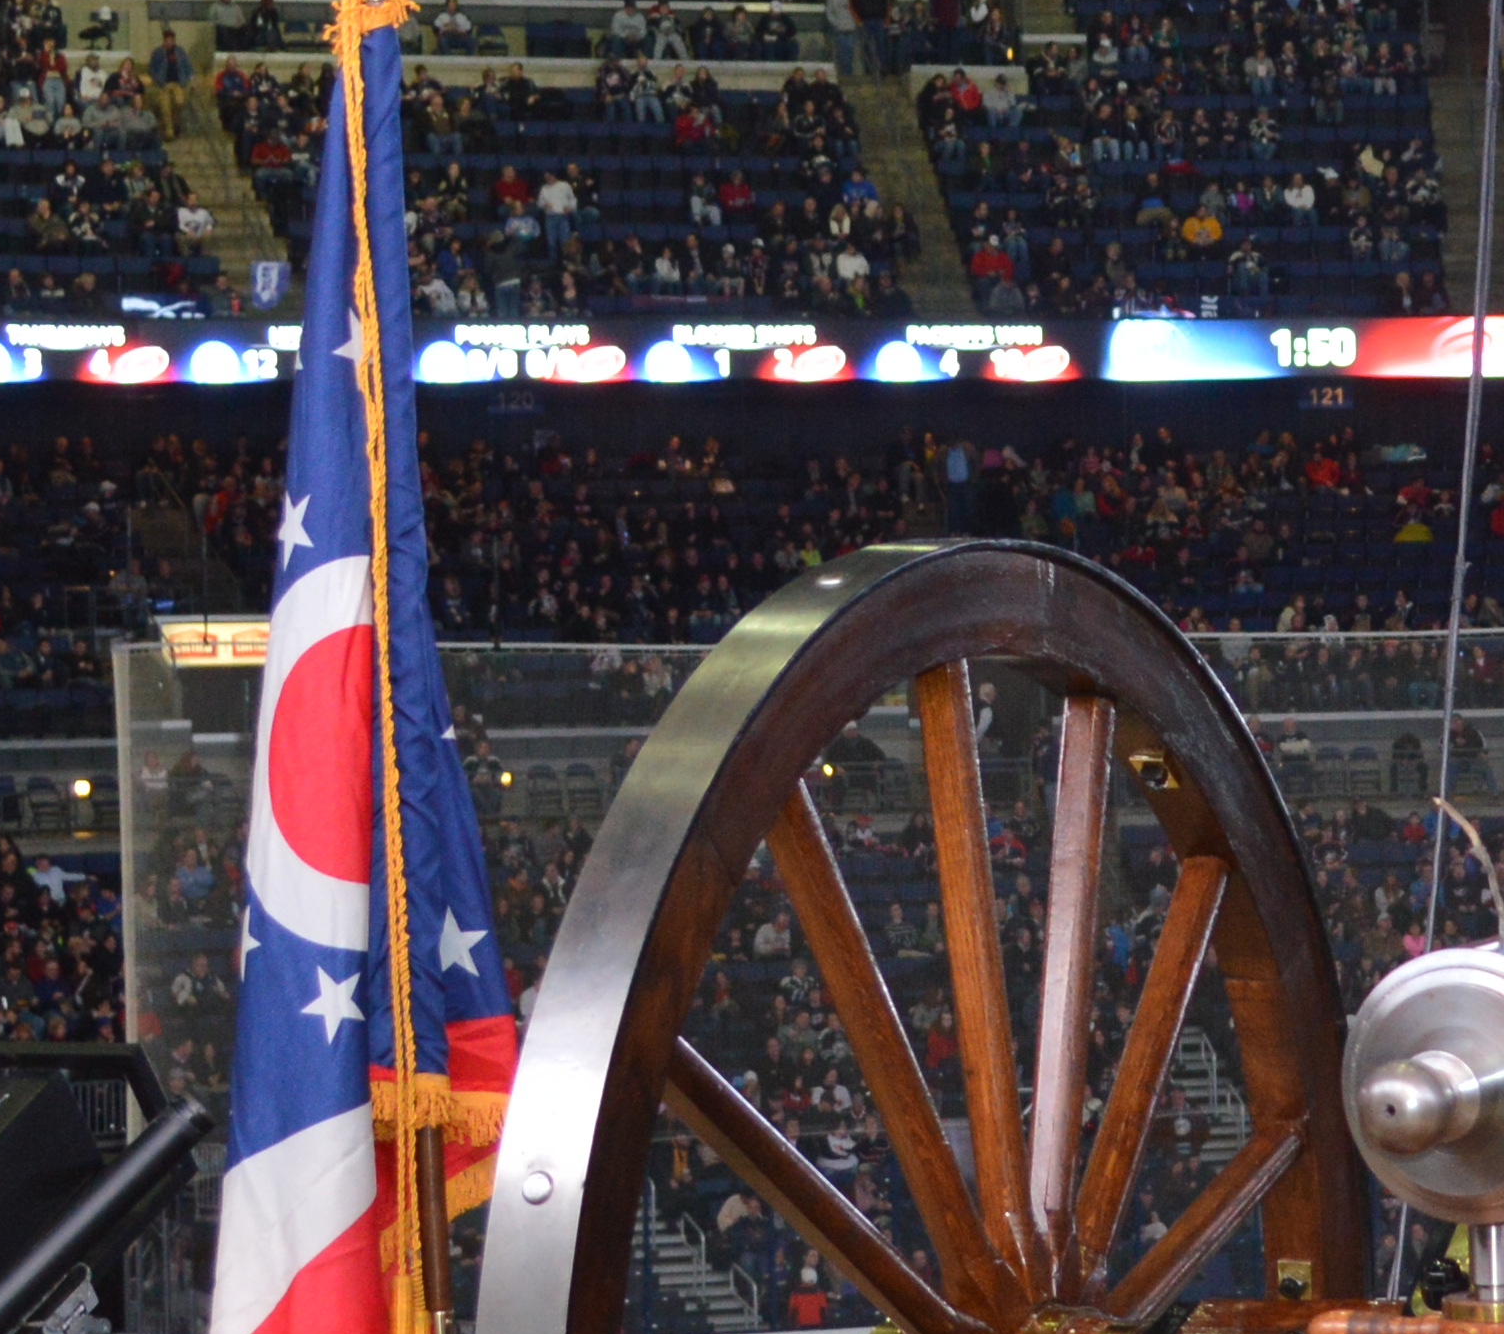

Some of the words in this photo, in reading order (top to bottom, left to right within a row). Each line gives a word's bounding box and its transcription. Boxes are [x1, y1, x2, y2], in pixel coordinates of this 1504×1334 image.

[528, 324, 590, 346] PLAYS
[756, 324, 817, 346] SHOTS
[1270, 326, 1357, 368] 1:50
[242, 348, 278, 379] 12
[714, 348, 731, 378] 1
[1309, 388, 1345, 405] 121
